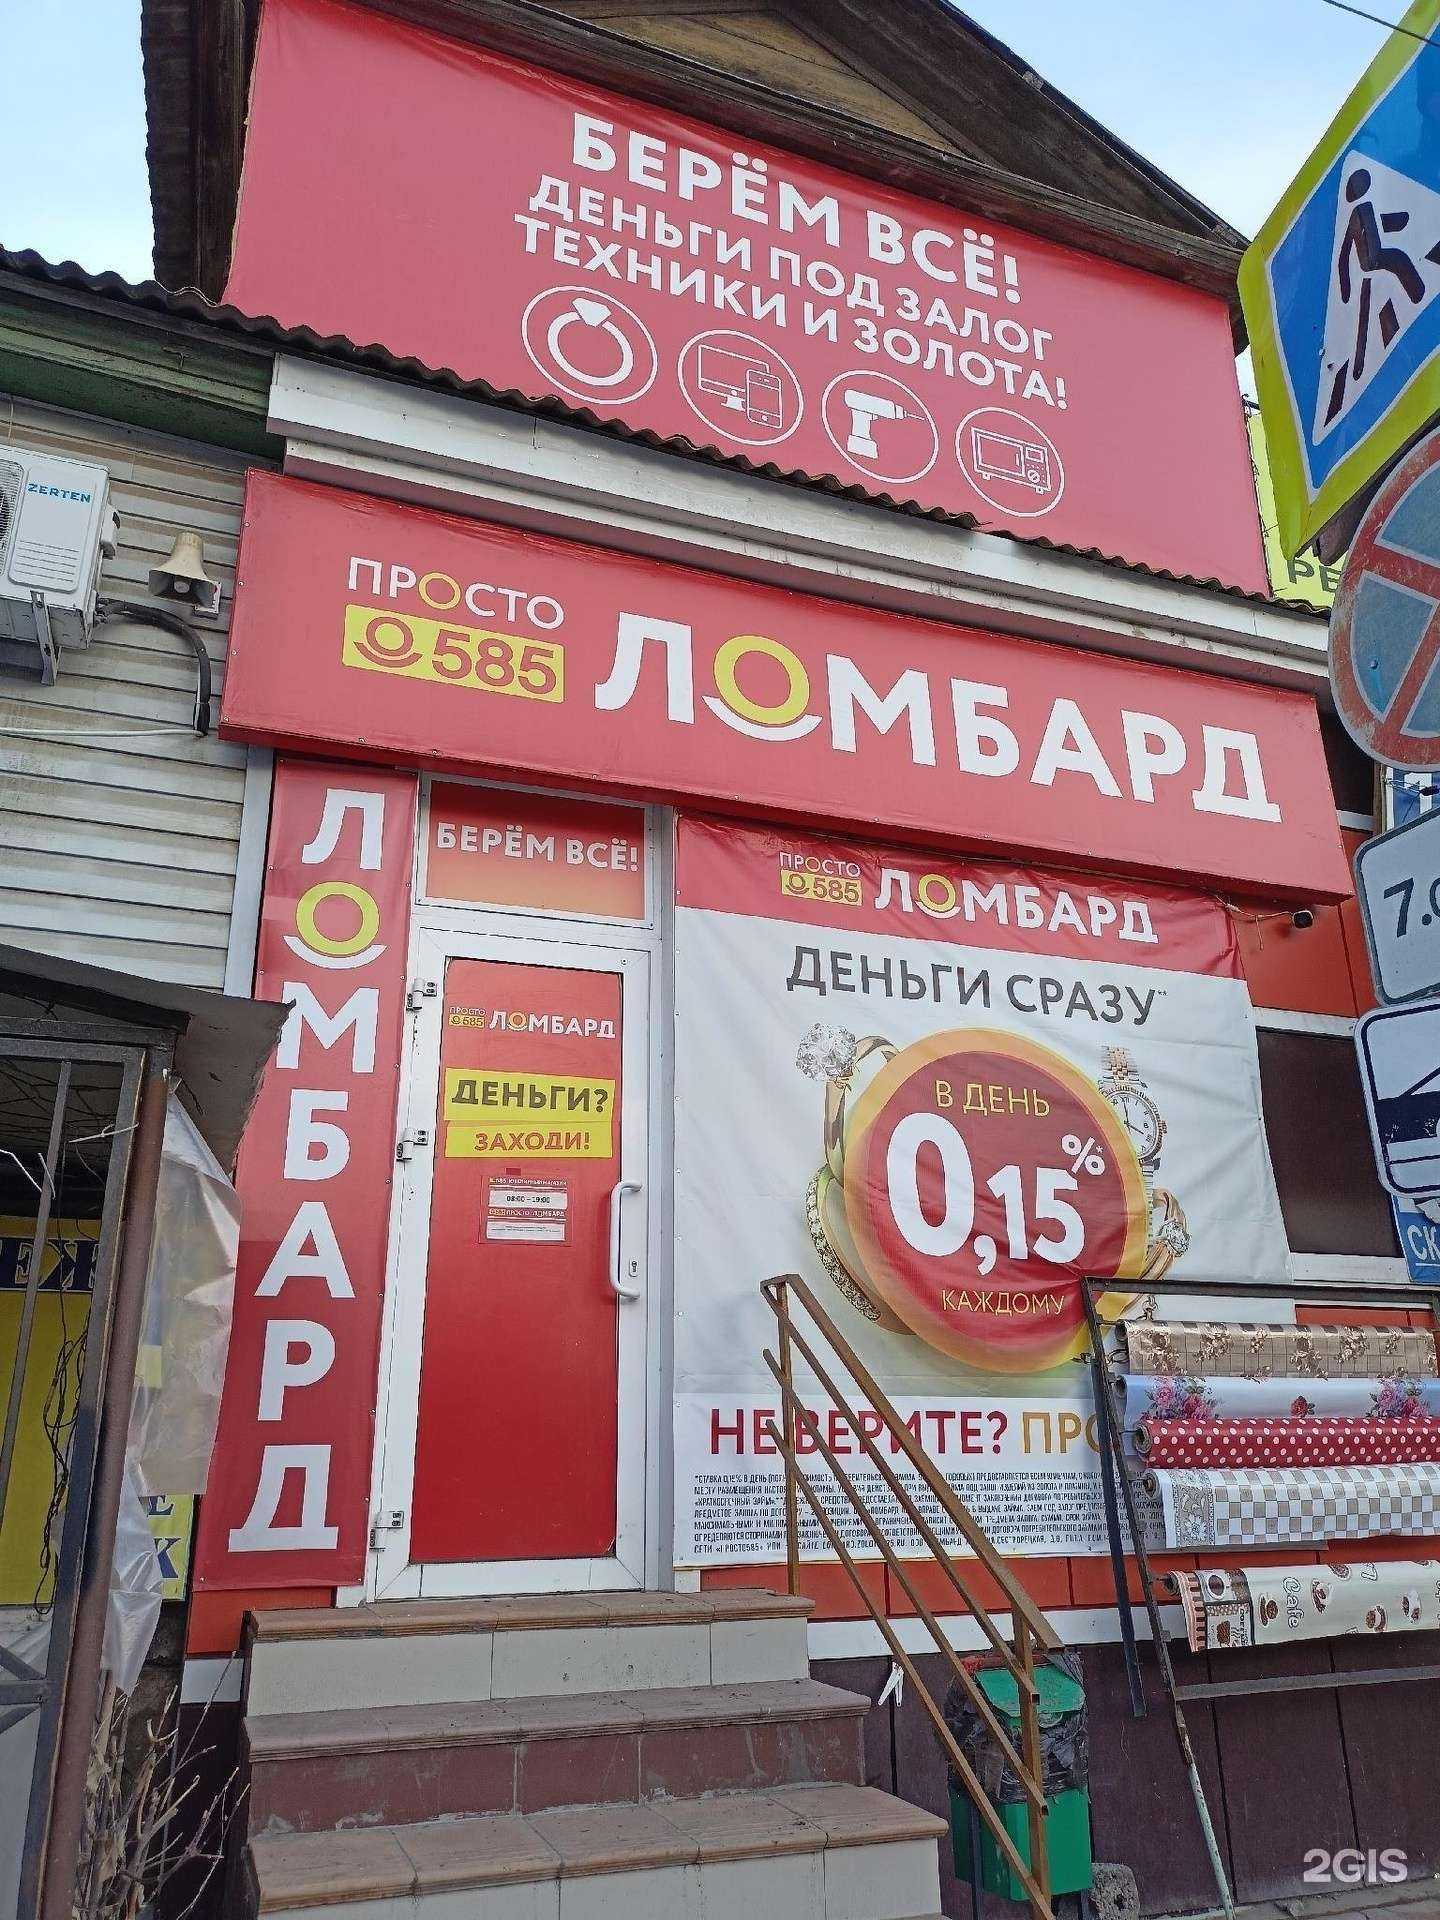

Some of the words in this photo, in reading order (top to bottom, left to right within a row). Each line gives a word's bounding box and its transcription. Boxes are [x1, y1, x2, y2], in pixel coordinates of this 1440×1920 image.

[571, 111, 840, 247] БЕРЁМ
[866, 209, 1022, 305] ВСЁ!
[529, 174, 751, 273] ДЕНЬГИ
[771, 250, 885, 318] ПОД
[896, 286, 1054, 363] ЗАЛОГ
[513, 212, 786, 328] ТЕХНИКИ
[803, 300, 839, 344] И
[852, 314, 1070, 411] ЗОЛОТА!
[28, 483, 91, 503] ZERTEN
[347, 556, 564, 629] ПРОСТО
[432, 629, 557, 694] 585
[594, 612, 1283, 823] ЛОМБАРД
[437, 824, 555, 862] БЕРЁМ
[565, 837, 639, 871] ВСЁ!
[779, 851, 861, 877] ПРОСТО
[812, 878, 860, 902] 585
[874, 868, 1159, 944] ЛОМБАРД
[1384, 877, 1440, 938] 7.
[786, 945, 991, 1009] ДЕНЬГИ
[450, 1006, 486, 1016] ПРОСТО
[462, 1016, 483, 1027] 585
[490, 1010, 616, 1039] ЛОМБАРД
[452, 1079, 609, 1113] ДЕНЬГИ?
[935, 1080, 953, 1108] В
[963, 1083, 1051, 1117] ДЕНЬ
[474, 1132, 590, 1151] ЗАХОДИ!
[228, 788, 387, 1552] ЛОМБАРД
[941, 1289, 1066, 1317] КАЖДОМУ
[711, 1409, 777, 1455] НЕ
[795, 1410, 1007, 1455] ВЕРИТЕ?
[1283, 1577, 1305, 1629] Cafe
